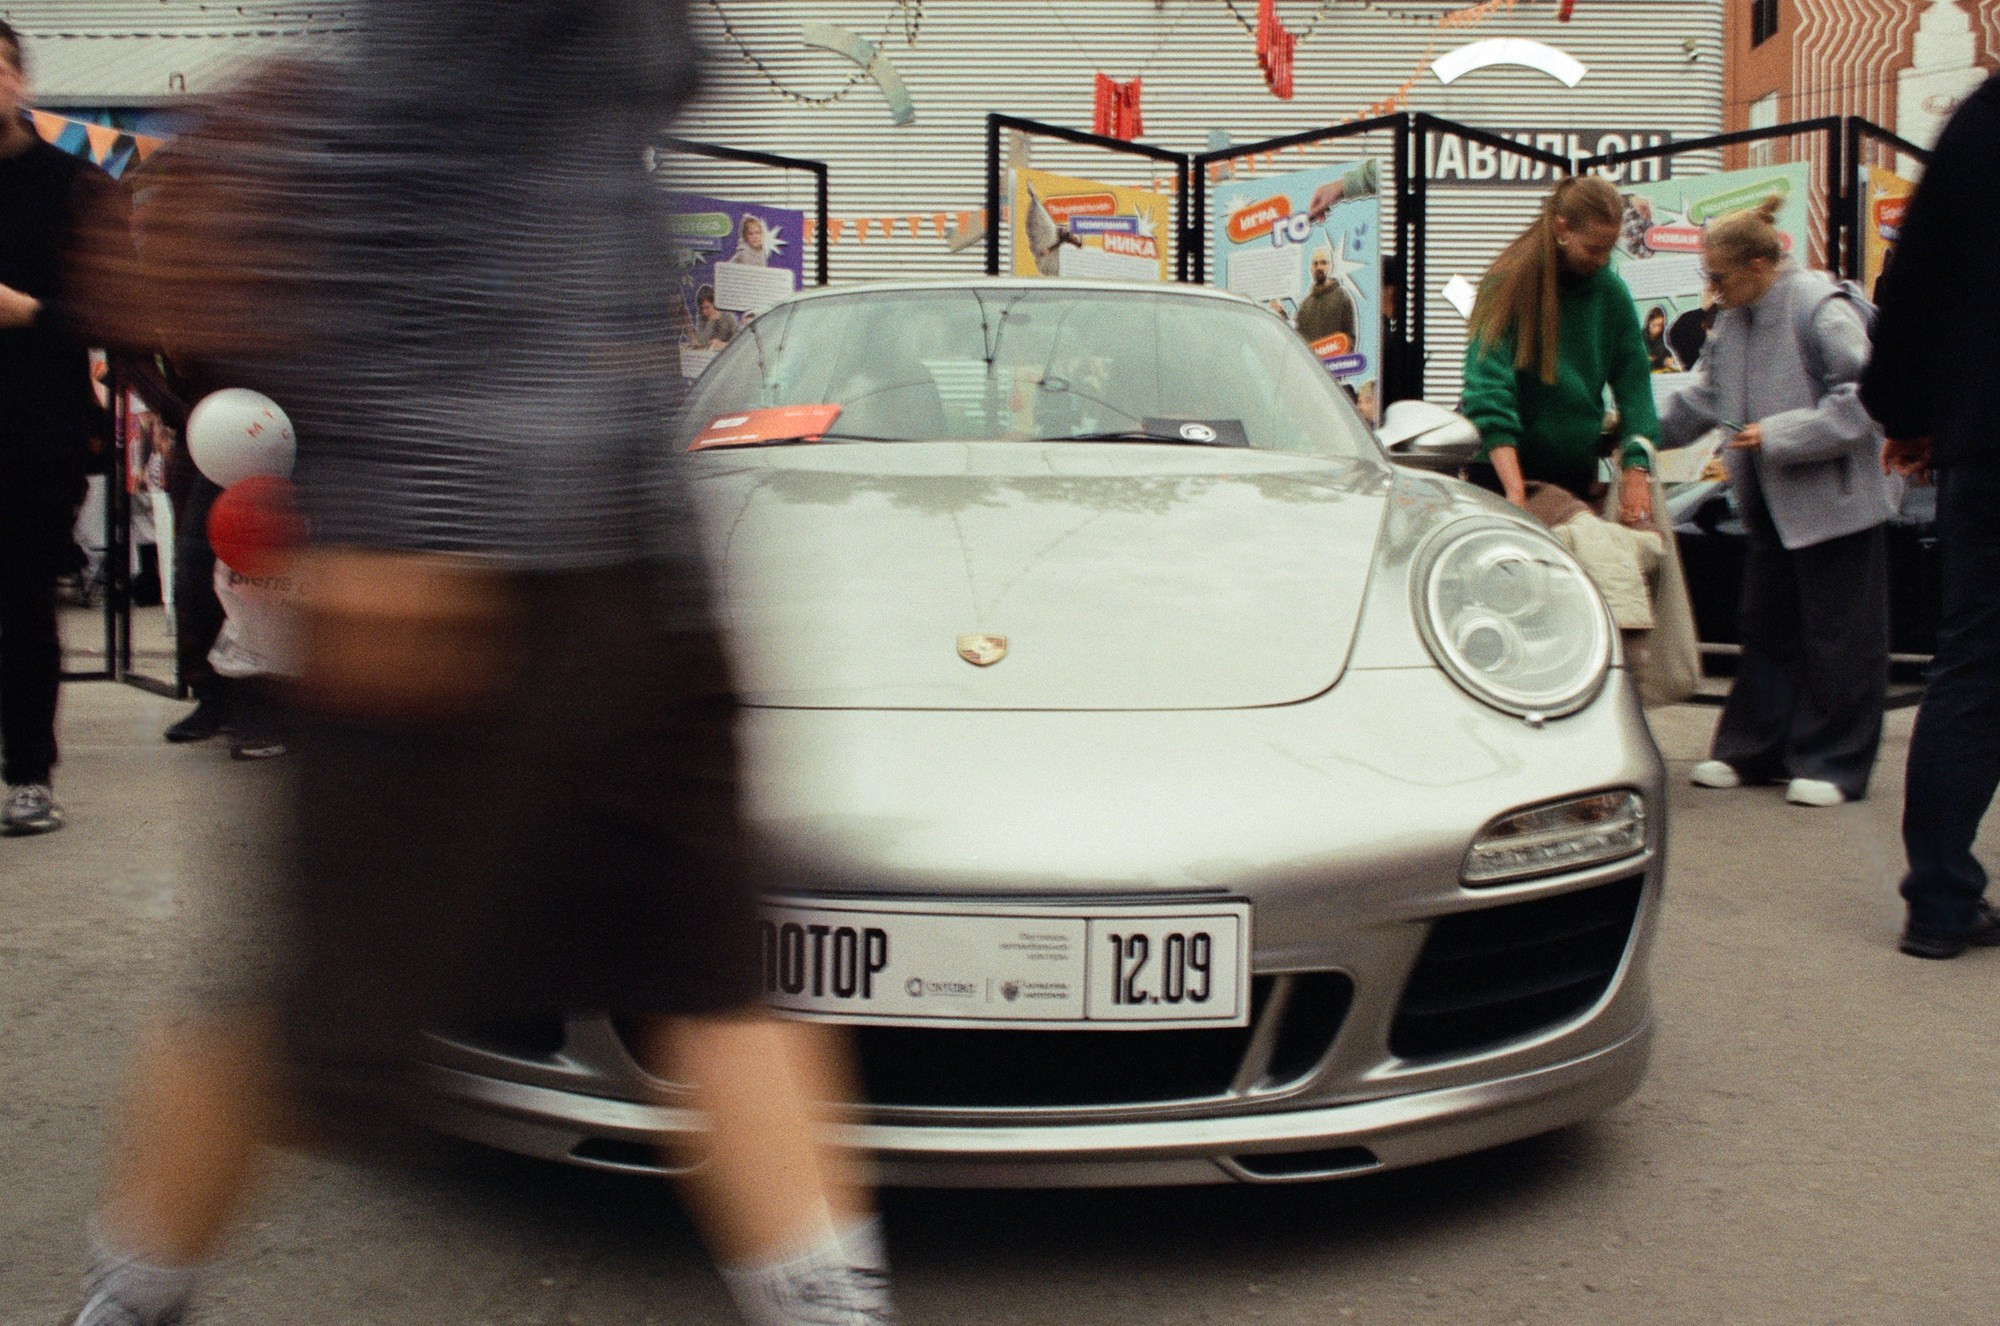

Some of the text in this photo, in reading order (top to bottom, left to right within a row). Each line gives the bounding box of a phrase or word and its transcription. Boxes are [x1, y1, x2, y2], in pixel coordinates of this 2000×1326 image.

[1240, 207, 1278, 231] ИГРА
[1104, 234, 1157, 258] НИКА
[1108, 931, 1211, 1005] 12.09
